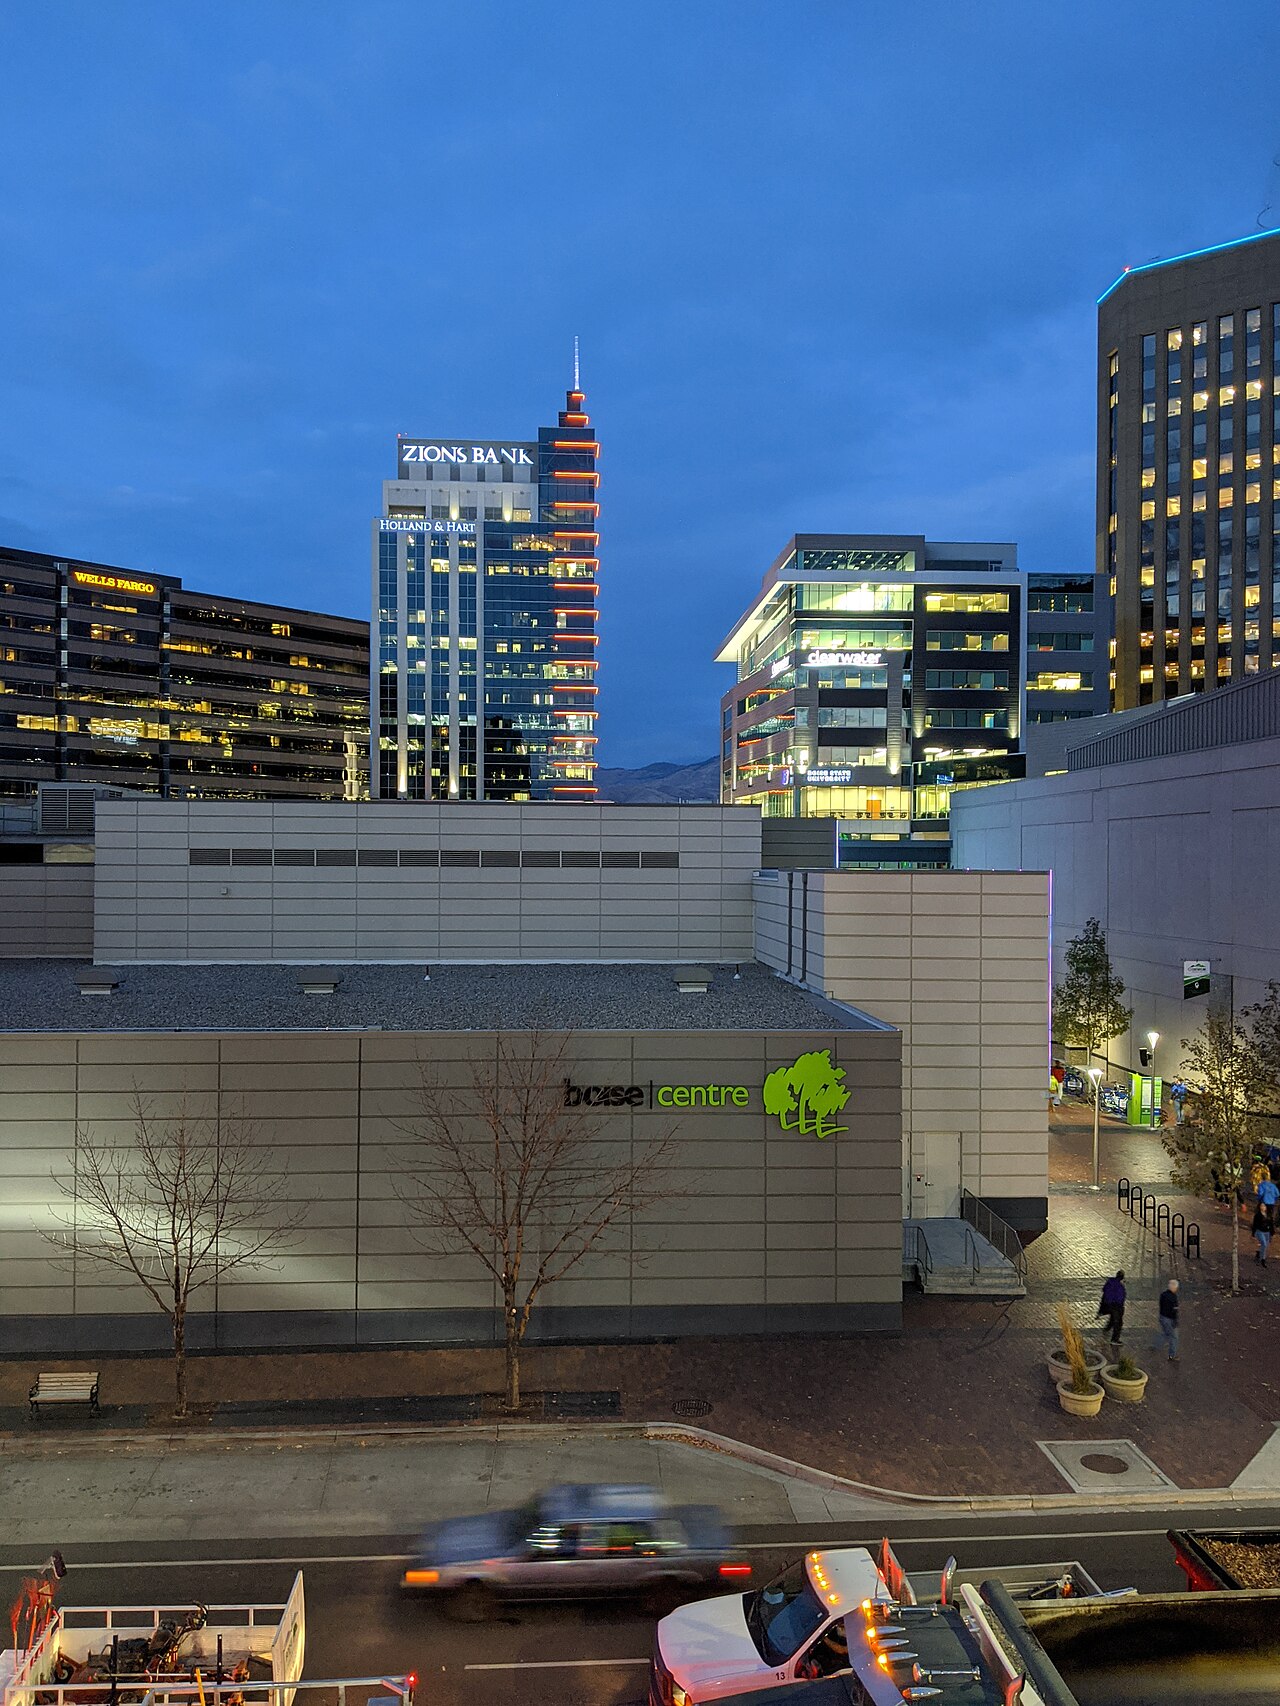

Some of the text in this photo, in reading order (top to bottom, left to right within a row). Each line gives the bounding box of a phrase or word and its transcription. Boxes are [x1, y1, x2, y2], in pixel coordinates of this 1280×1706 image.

[402, 444, 534, 465] ZIONS BANK
[379, 519, 476, 533] HOLLAND & HART
[74, 571, 155, 593] WELLS FARGO
[807, 649, 882, 664] clearwater
[657, 1083, 750, 1107] centre
[775, 1671, 786, 1681] 13
